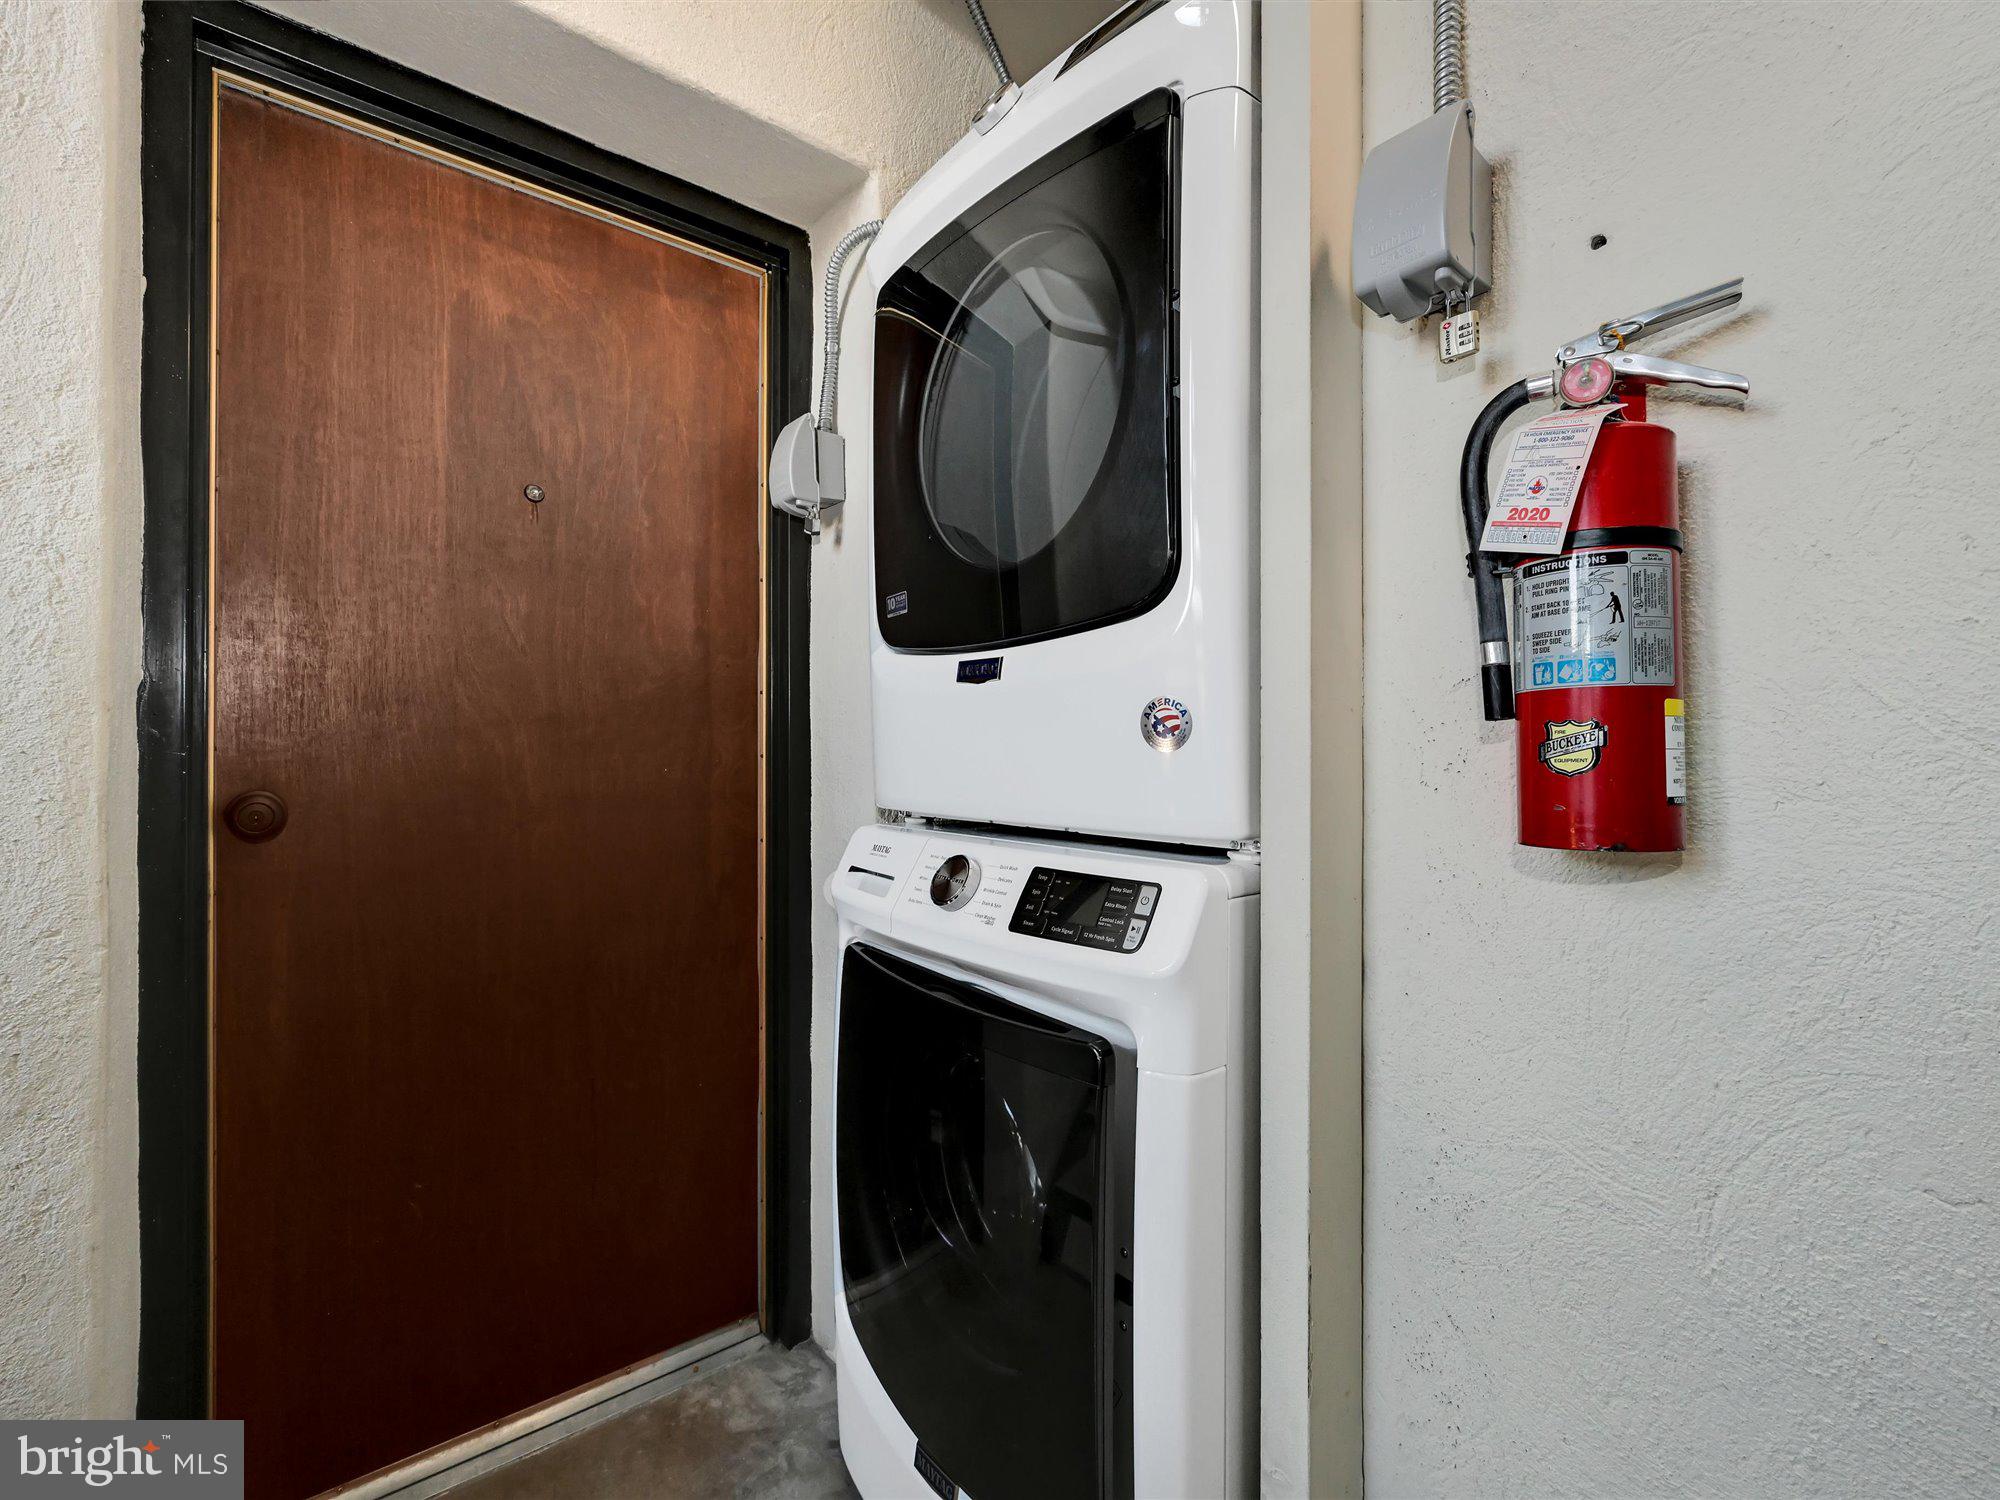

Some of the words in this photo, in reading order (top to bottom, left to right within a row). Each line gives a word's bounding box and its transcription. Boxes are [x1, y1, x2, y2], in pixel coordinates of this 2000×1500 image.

[1542, 429, 1571, 437] EMERGENCY
[1506, 507, 1551, 521] 2020
[1532, 582, 1545, 591] HOLD
[1545, 577, 1570, 587] UPRIGHT
[1532, 590, 1544, 598] PULL
[1544, 588, 1559, 596] RING
[1559, 585, 1570, 593] PIN
[887, 598, 896, 611] 10
[895, 594, 906, 602] YEAR
[1531, 603, 1546, 612] START
[1546, 601, 1561, 609] BACK
[1547, 608, 1561, 616] BASE
[1532, 630, 1553, 640] SQUEEZE
[1532, 638, 1549, 648] SWEEP
[1549, 637, 1562, 645] SIDE
[1532, 647, 1539, 655] TO
[1539, 646, 1551, 654] SIDE
[1143, 697, 1188, 721] AMERICA
[1546, 730, 1597, 754] BUCKEYE
[1031, 888, 1041, 896] Spin
[1110, 886, 1123, 894] Delay
[1104, 901, 1117, 909] Extra
[1116, 902, 1128, 910] Rinse
[1099, 915, 1114, 924] Control
[1113, 917, 1125, 925] Lock
[1050, 925, 1062, 933] Cycle
[1061, 927, 1075, 935] Signal
[1094, 933, 1105, 941] Fresh
